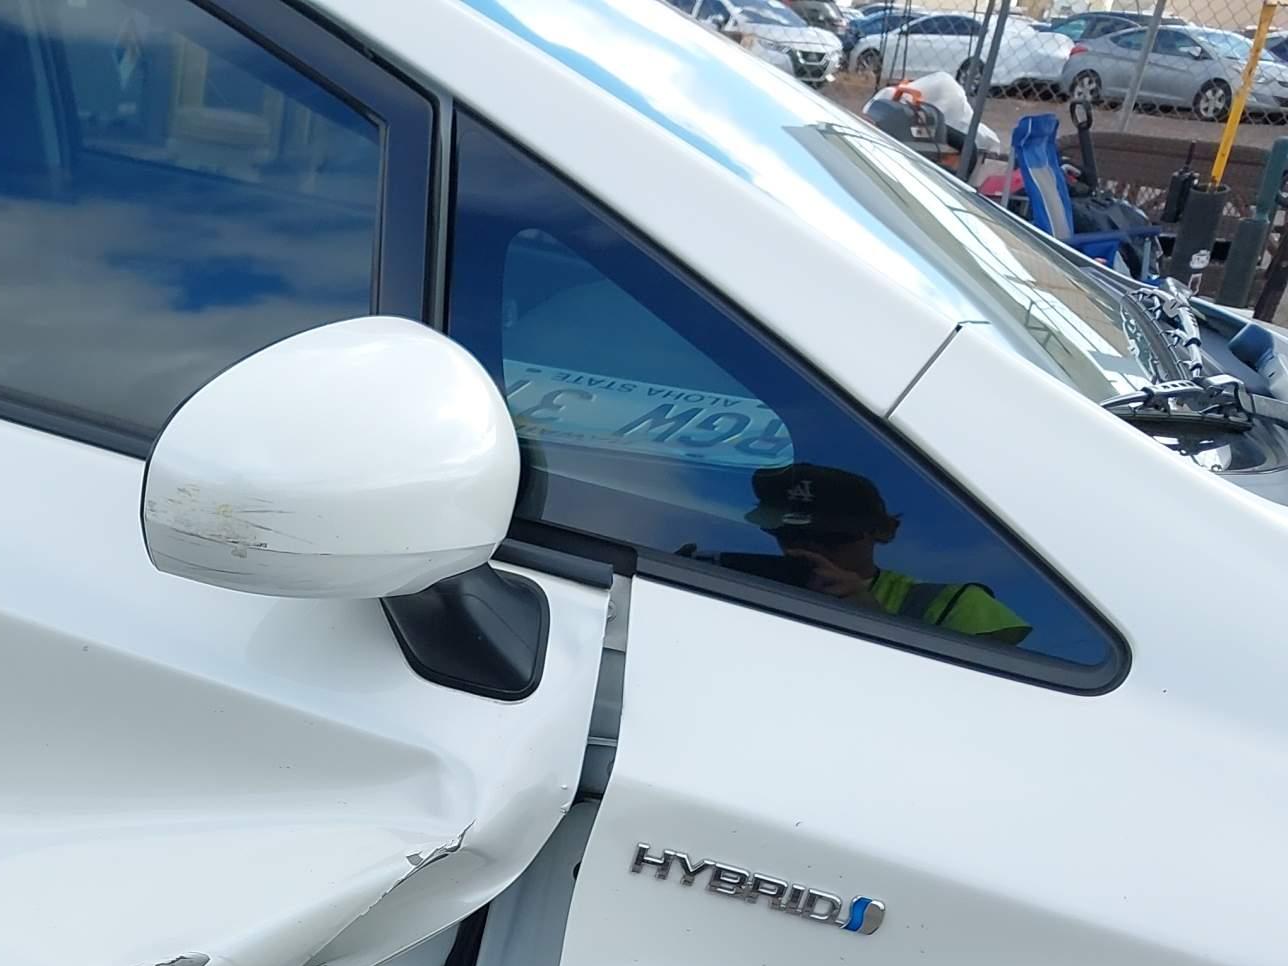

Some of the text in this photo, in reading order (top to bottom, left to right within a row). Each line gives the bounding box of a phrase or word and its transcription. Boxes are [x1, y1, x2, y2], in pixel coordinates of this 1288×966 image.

[553, 373, 739, 408] ALOHA STATE
[614, 402, 794, 457] RGW
[631, 842, 843, 920] HYBRID
